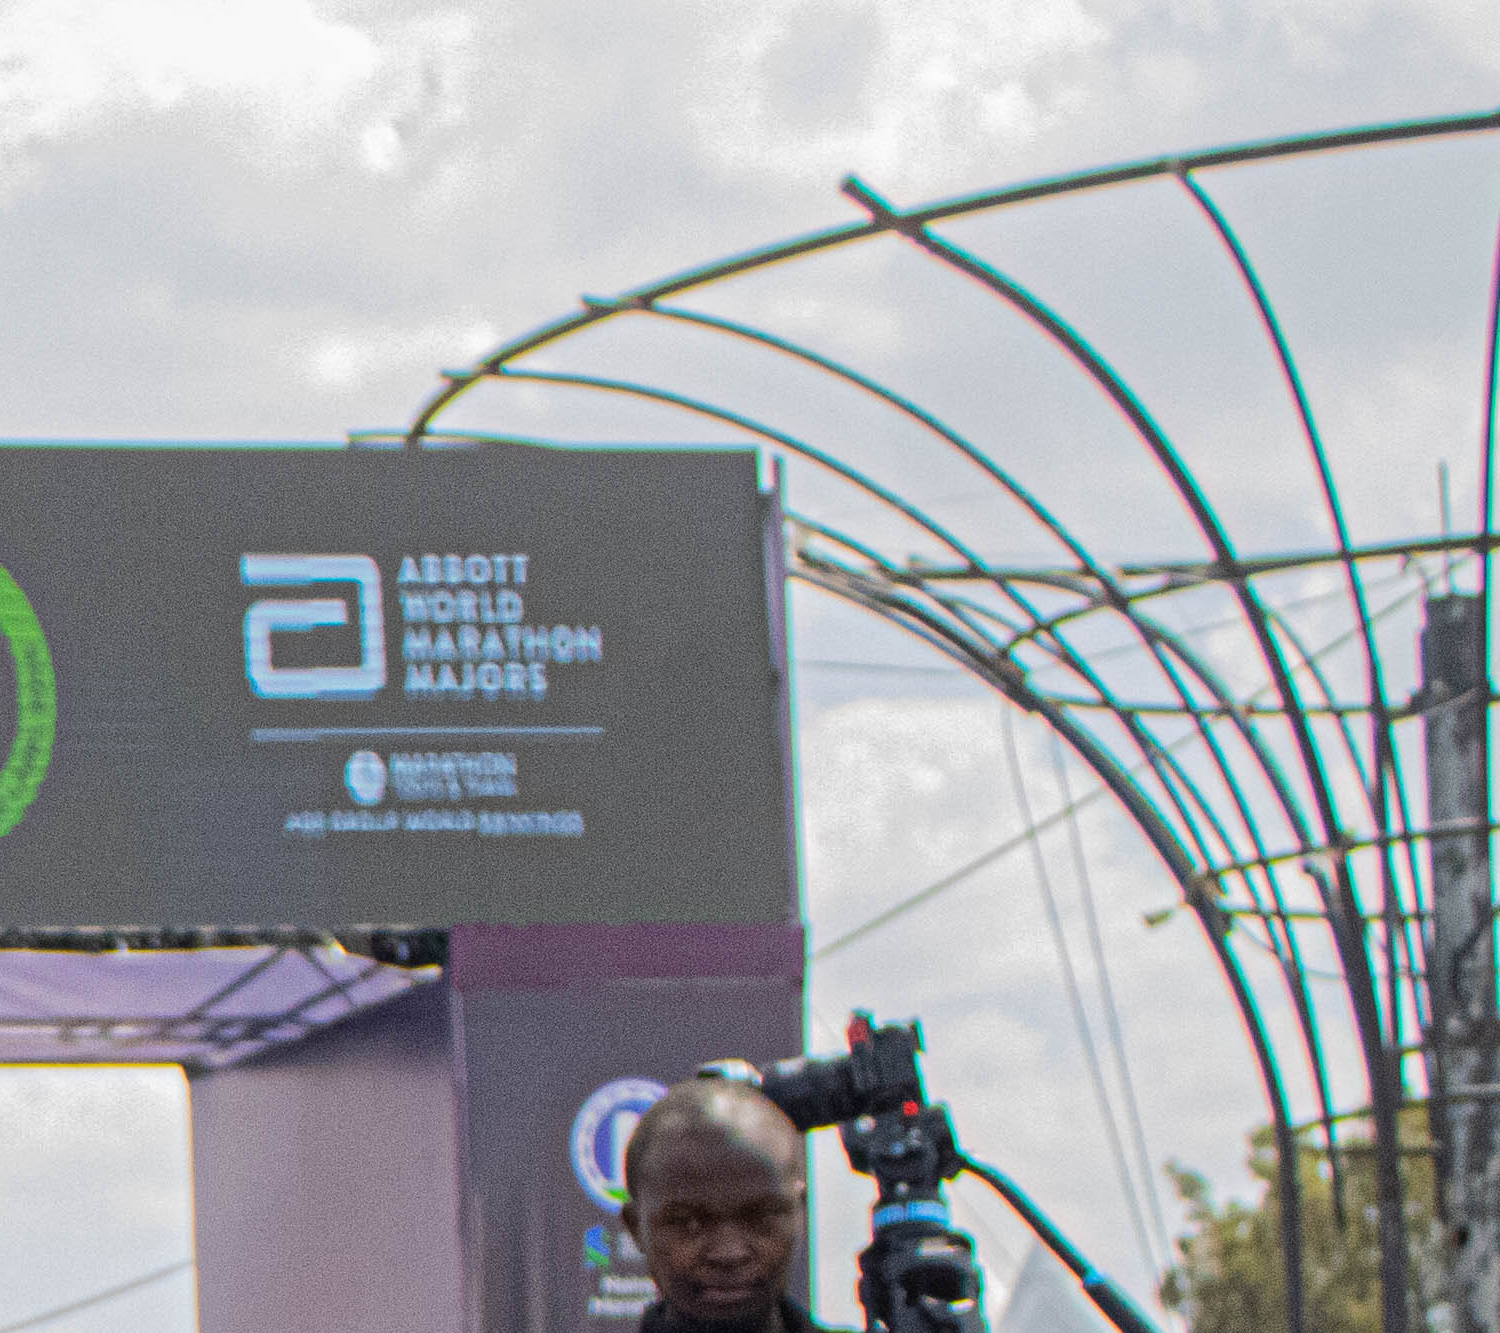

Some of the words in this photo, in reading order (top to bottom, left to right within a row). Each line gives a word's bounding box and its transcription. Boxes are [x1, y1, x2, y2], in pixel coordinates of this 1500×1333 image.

[398, 553, 529, 584] ABBOTT
[400, 588, 524, 624] WORLD
[402, 625, 602, 663] MARATHON
[404, 664, 547, 700] MAJORS
